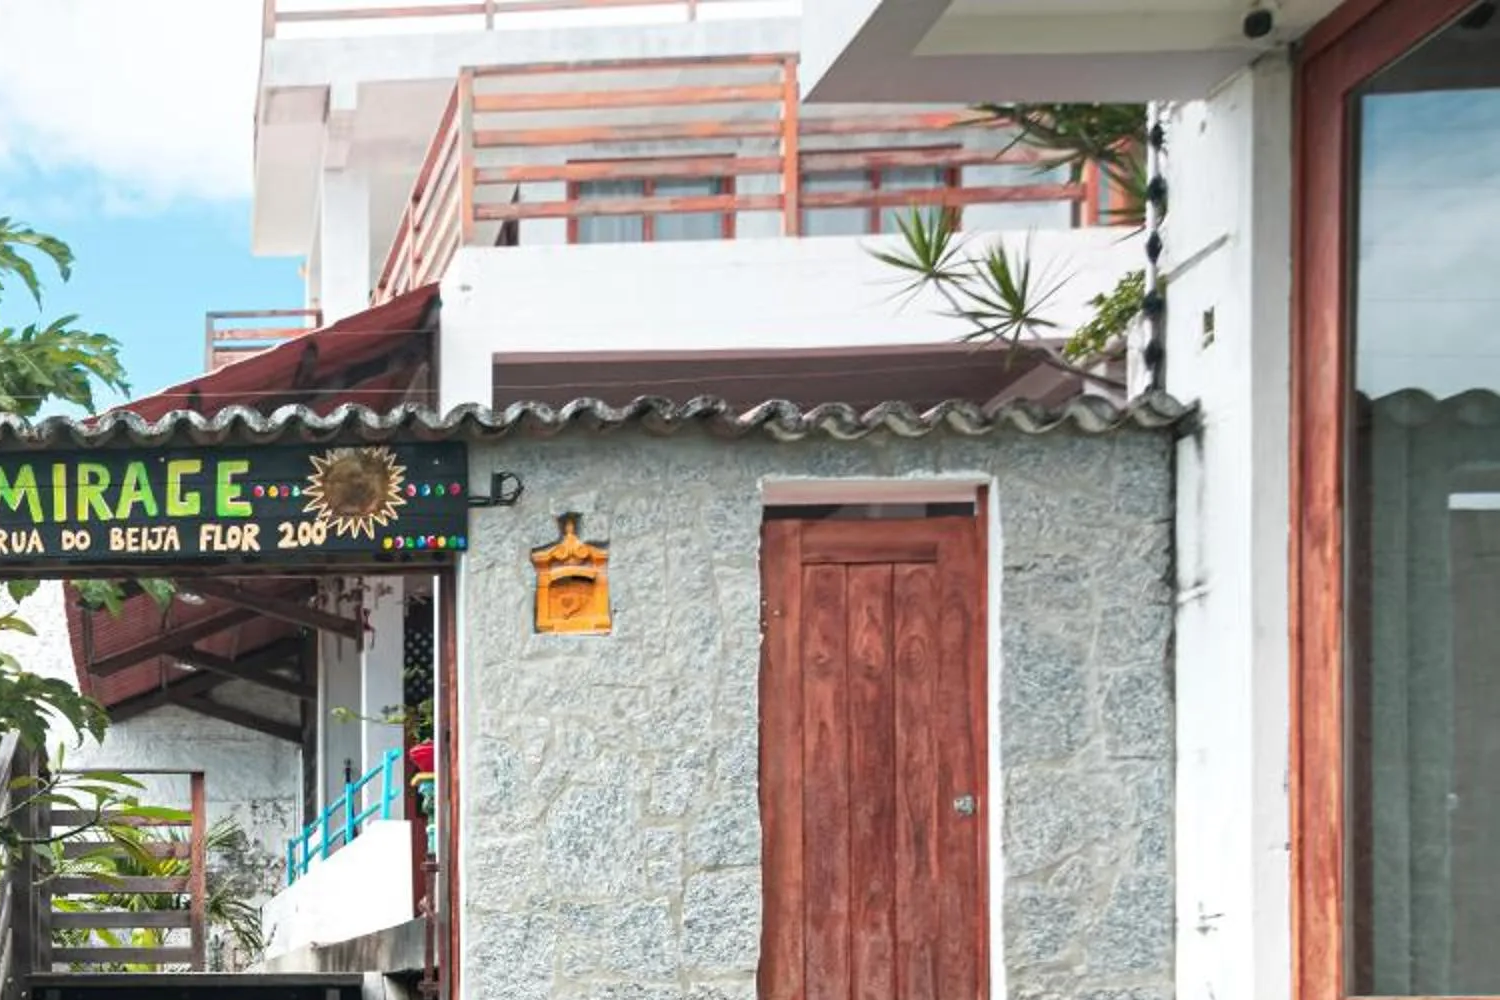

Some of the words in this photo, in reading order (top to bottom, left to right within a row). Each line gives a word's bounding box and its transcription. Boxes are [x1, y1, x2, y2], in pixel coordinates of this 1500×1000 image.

[61, 529, 91, 552] DO
[109, 526, 180, 554] BEIJA
[199, 523, 261, 552] FLOR
[277, 520, 328, 549] 200
